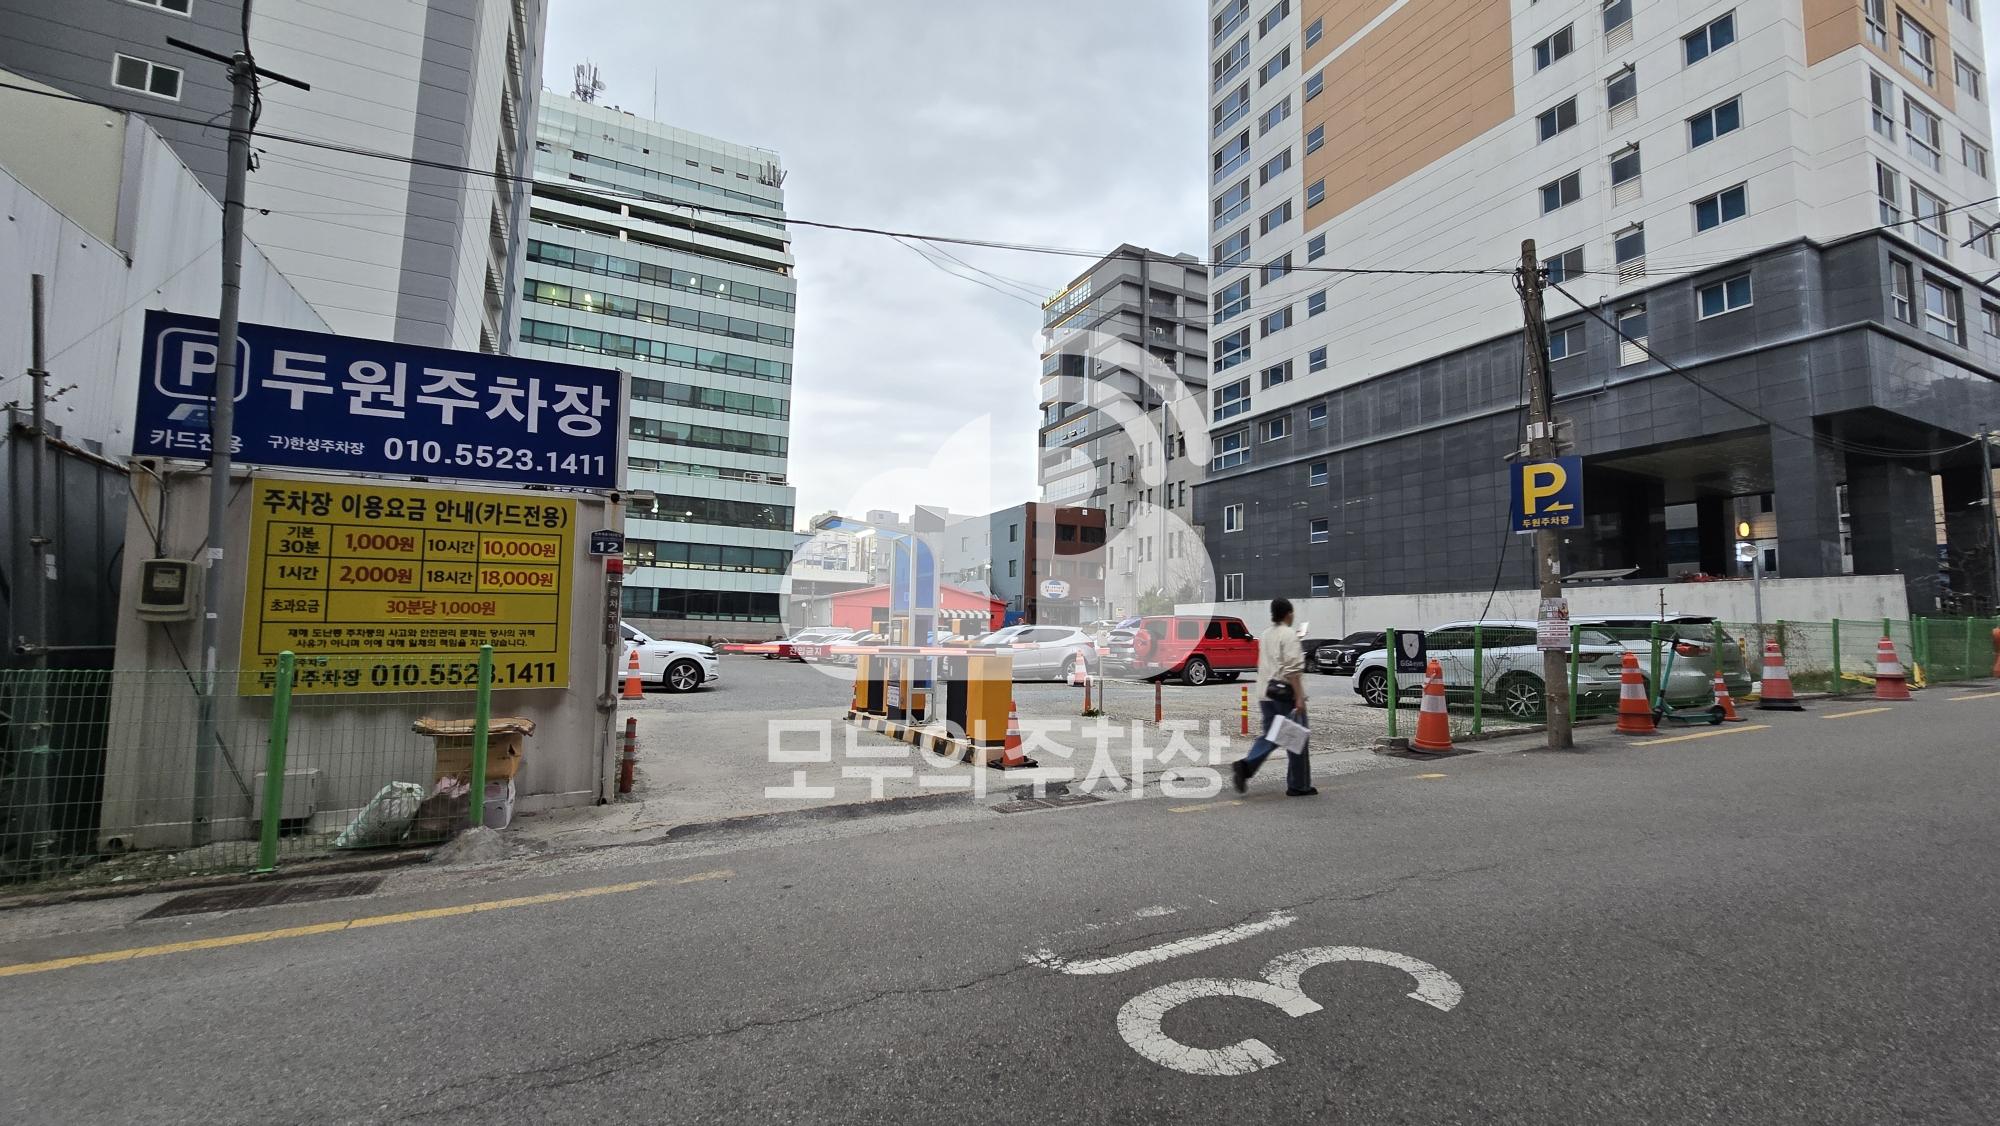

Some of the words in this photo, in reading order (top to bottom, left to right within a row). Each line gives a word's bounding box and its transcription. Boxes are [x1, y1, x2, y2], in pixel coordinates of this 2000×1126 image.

[261, 349, 611, 437] 두원주차장
[267, 435, 365, 455] 구)한성주차장
[383, 437, 605, 476] 010.5523.1411
[1523, 462, 1567, 515] P
[263, 489, 333, 516] 주차장
[341, 494, 427, 521] 이용요금
[1522, 515, 1570, 528] 두원주차장
[287, 526, 315, 539] 기본
[279, 540, 320, 554] 30분
[345, 533, 415, 552] 1,000원
[427, 539, 475, 554] 10시간
[483, 541, 556, 558] 10,000원
[596, 541, 619, 553] 12
[278, 565, 319, 581] 1시간
[340, 565, 412, 584] 2,000원
[426, 570, 473, 585] 18시간
[481, 570, 553, 587] 18,000원
[270, 599, 320, 613] 초과요금
[385, 600, 437, 615] 30분당
[441, 600, 496, 616] 1,000원
